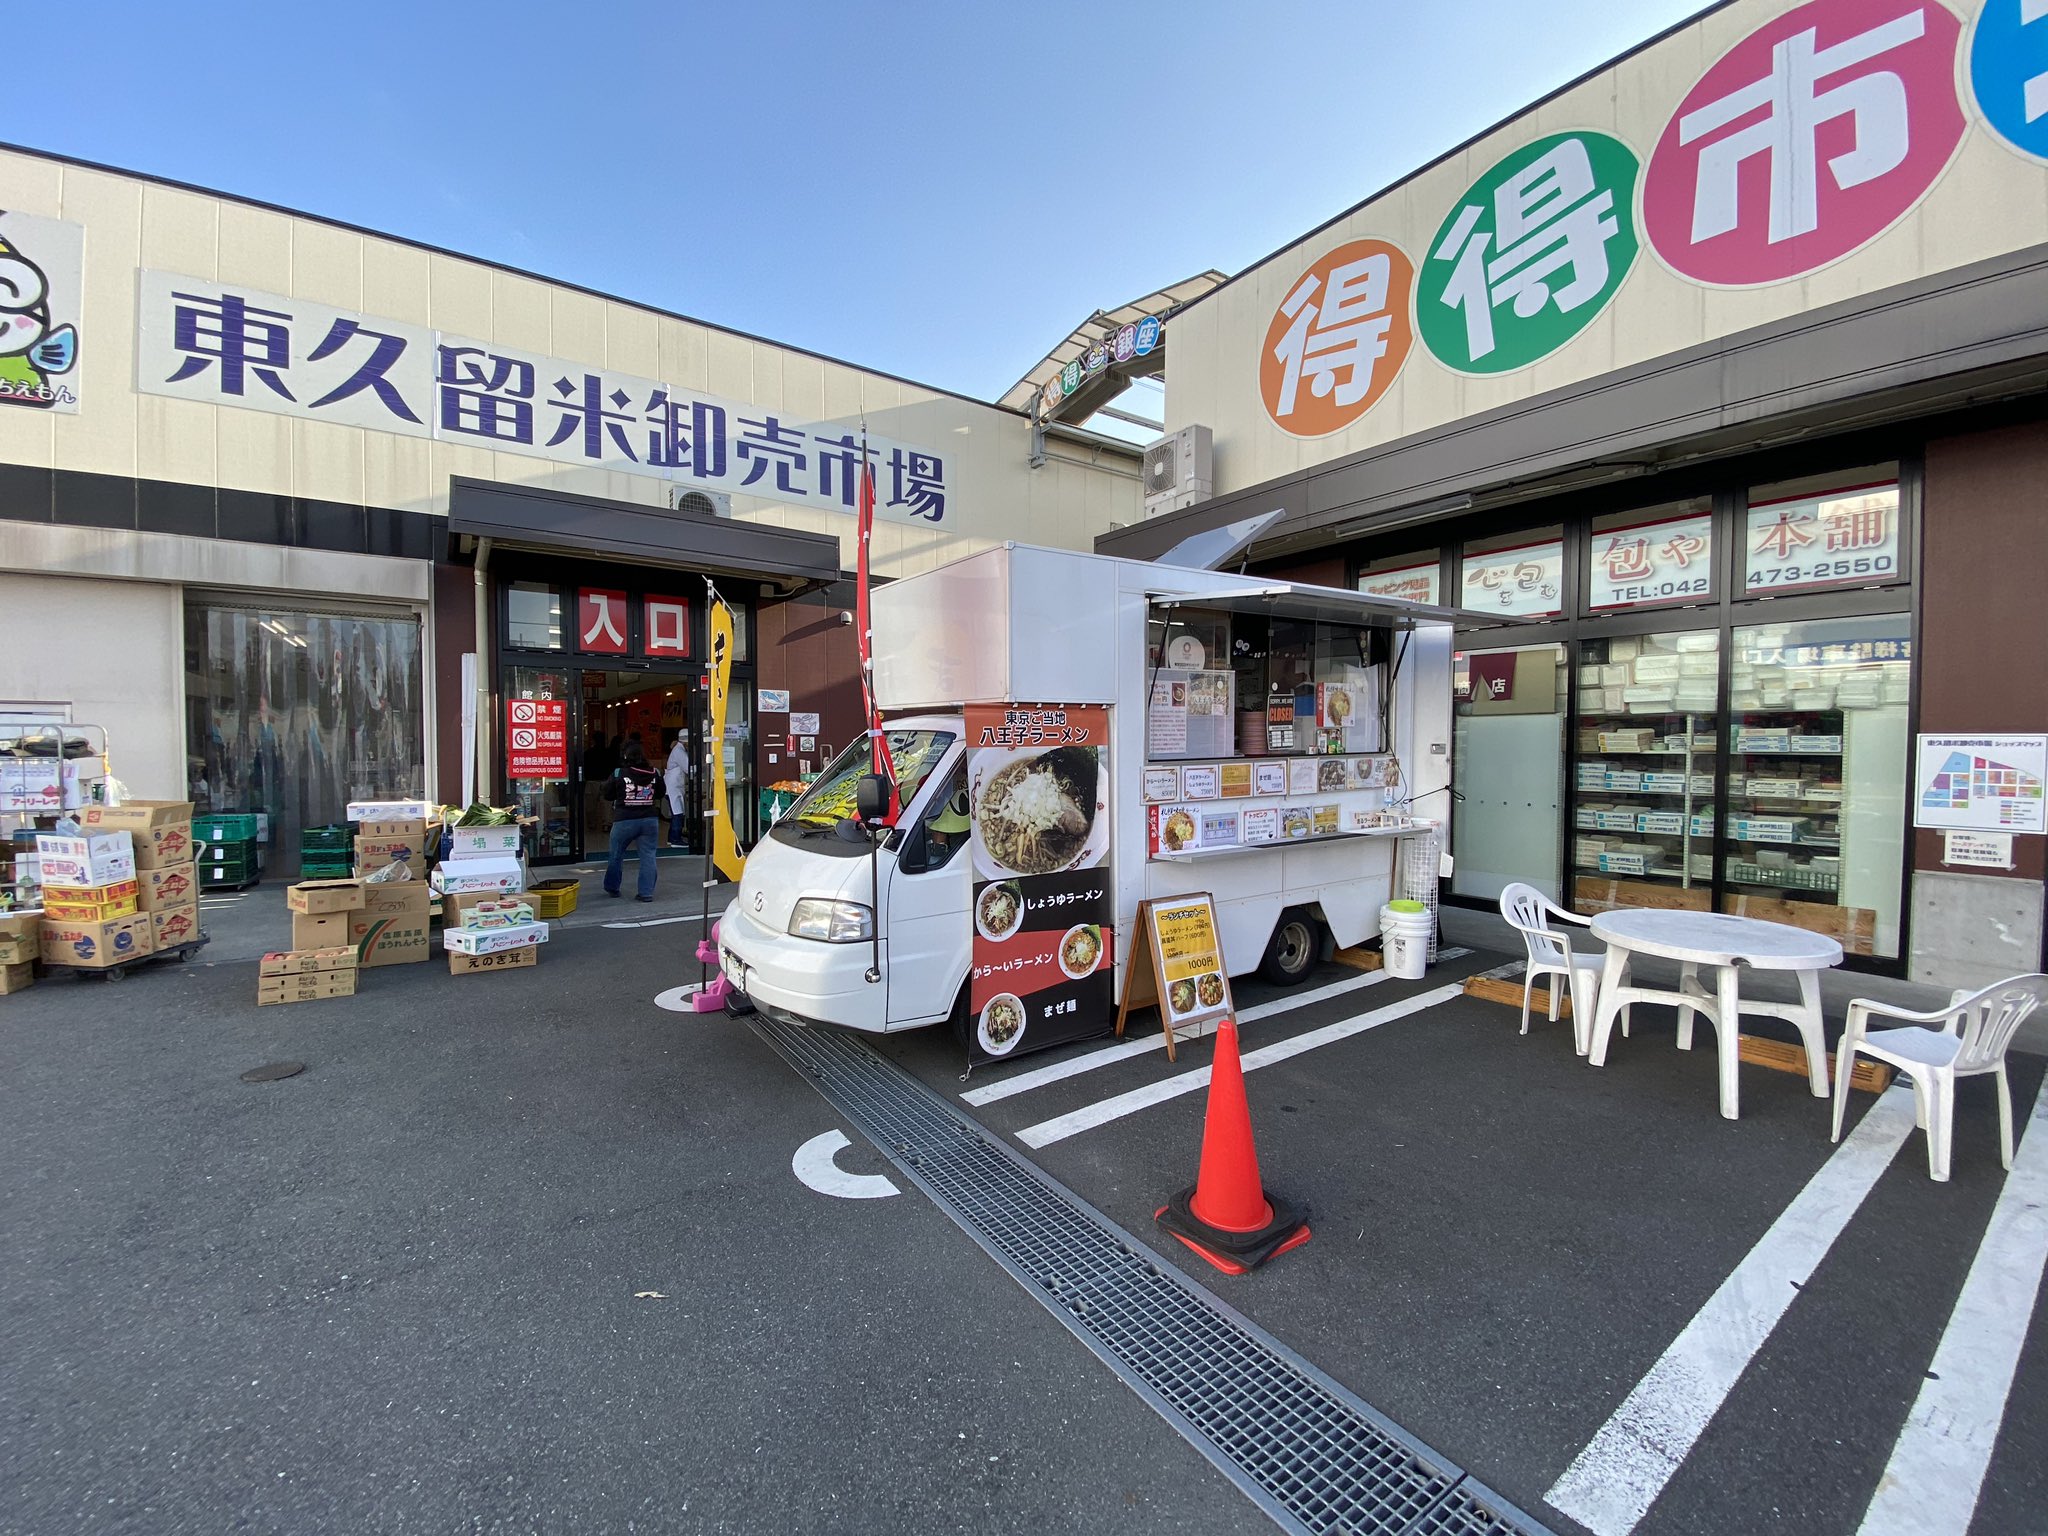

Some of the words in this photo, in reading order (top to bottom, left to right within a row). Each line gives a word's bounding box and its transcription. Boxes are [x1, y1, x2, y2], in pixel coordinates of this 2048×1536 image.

[1117, 321, 1158, 358] 銀座
[165, 290, 946, 523] 東久留米卸売市場
[1602, 533, 1704, 582] 包や
[1748, 555, 1892, 584] 473-2550
[1612, 578, 1707, 600] TEL:042
[584, 594, 684, 650] 入口
[521, 689, 552, 700] 館内
[537, 705, 562, 714] 禁煙
[1269, 707, 1293, 722] CLOSED
[1005, 711, 1066, 726] 東京ご当地
[537, 731, 562, 740] 火気厳禁
[979, 726, 1090, 745] 八王子ラーメン
[512, 757, 562, 766] 危険物品持込厳禁
[11, 798, 60, 806] アーリーレッ
[1027, 889, 1103, 910] しょうゆラーメン
[378, 937, 427, 949] ほうれんそう
[468, 953, 521, 968] えのき茸
[973, 953, 1054, 980] から〜いラーメン
[1188, 956, 1214, 969] 1000円
[1043, 999, 1077, 1018] まぜ麺
